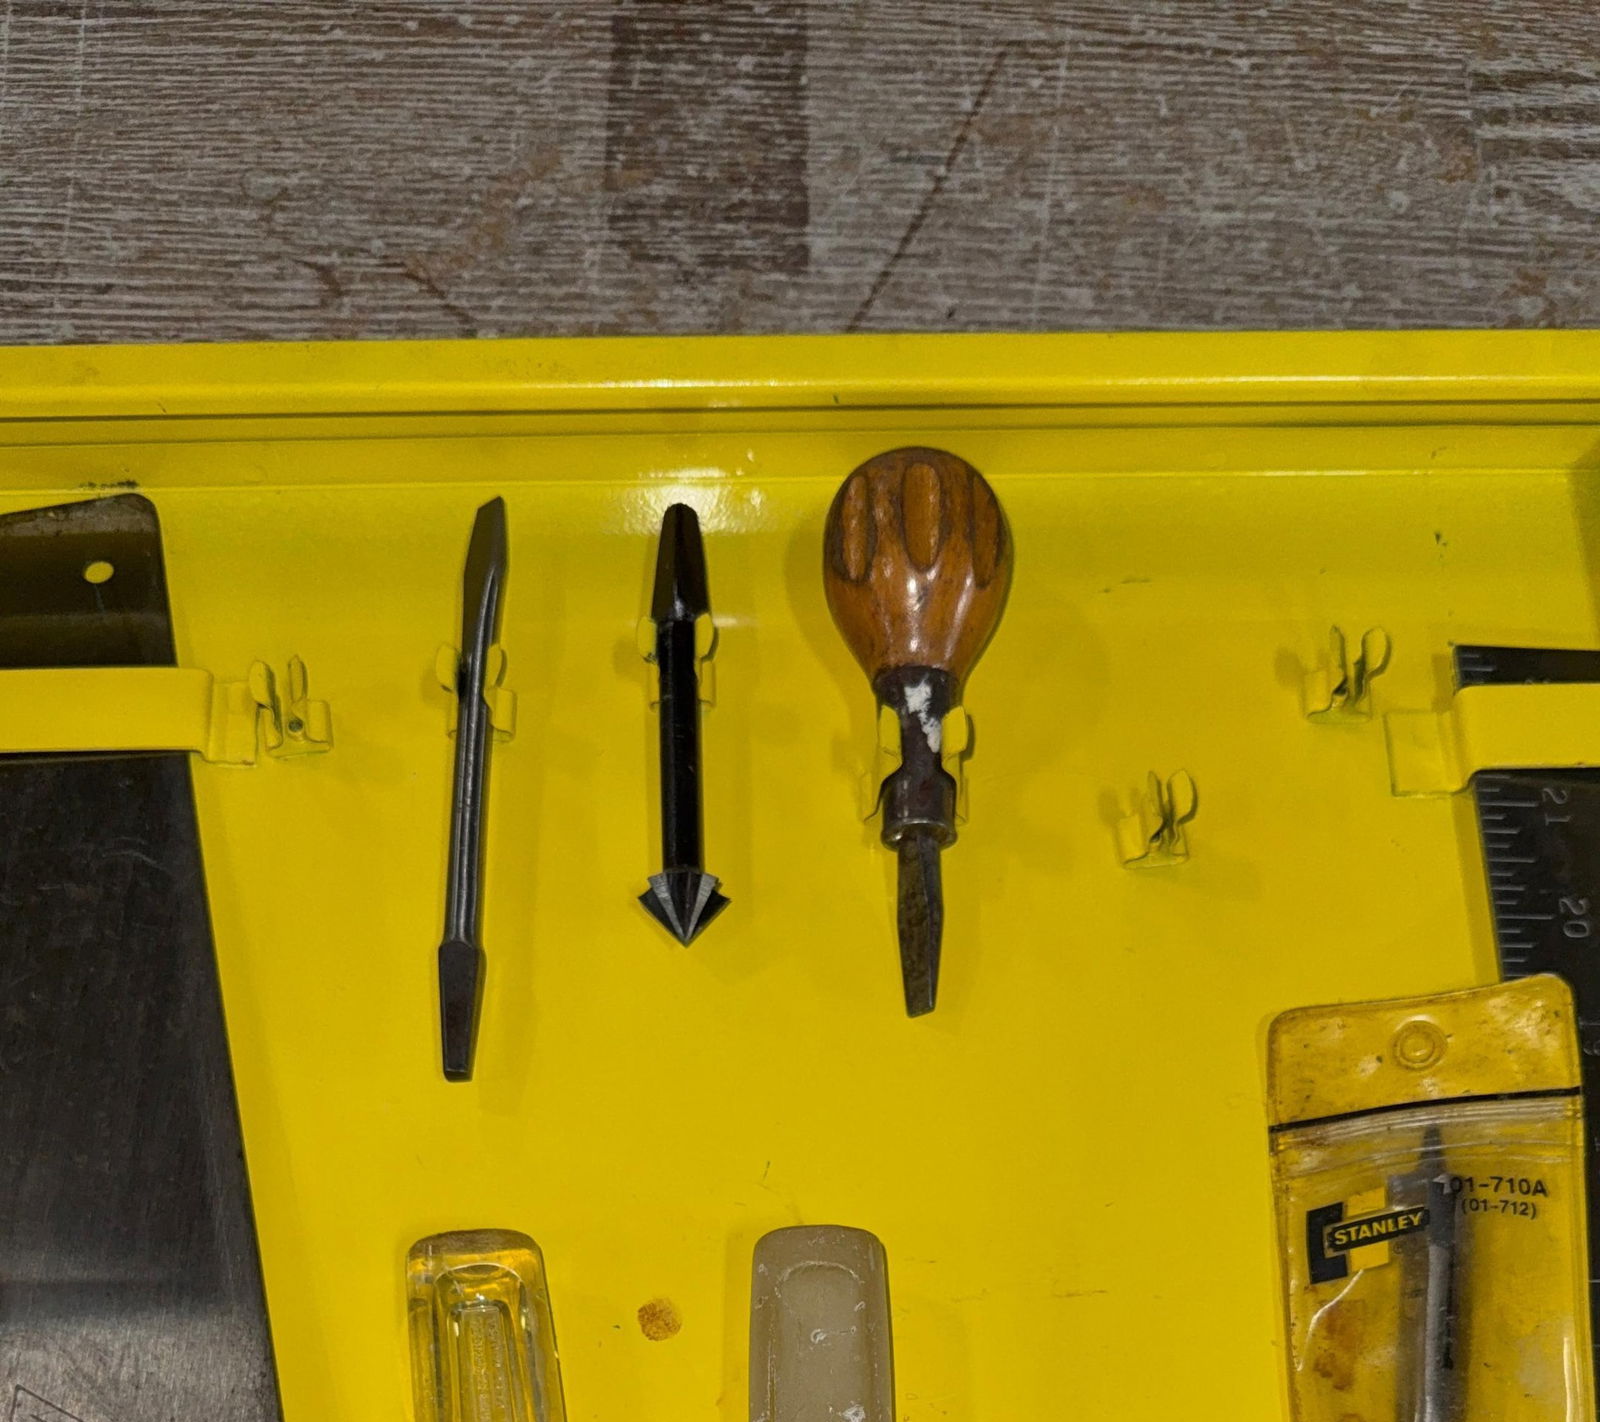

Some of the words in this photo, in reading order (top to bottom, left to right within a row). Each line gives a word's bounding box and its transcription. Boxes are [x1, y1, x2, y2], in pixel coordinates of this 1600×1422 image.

[1558, 897, 1591, 939] 20
[1449, 1175, 1549, 1198] 01-710A
[1461, 1198, 1538, 1220] (01-712)
[1333, 1211, 1424, 1246] STANLEY
